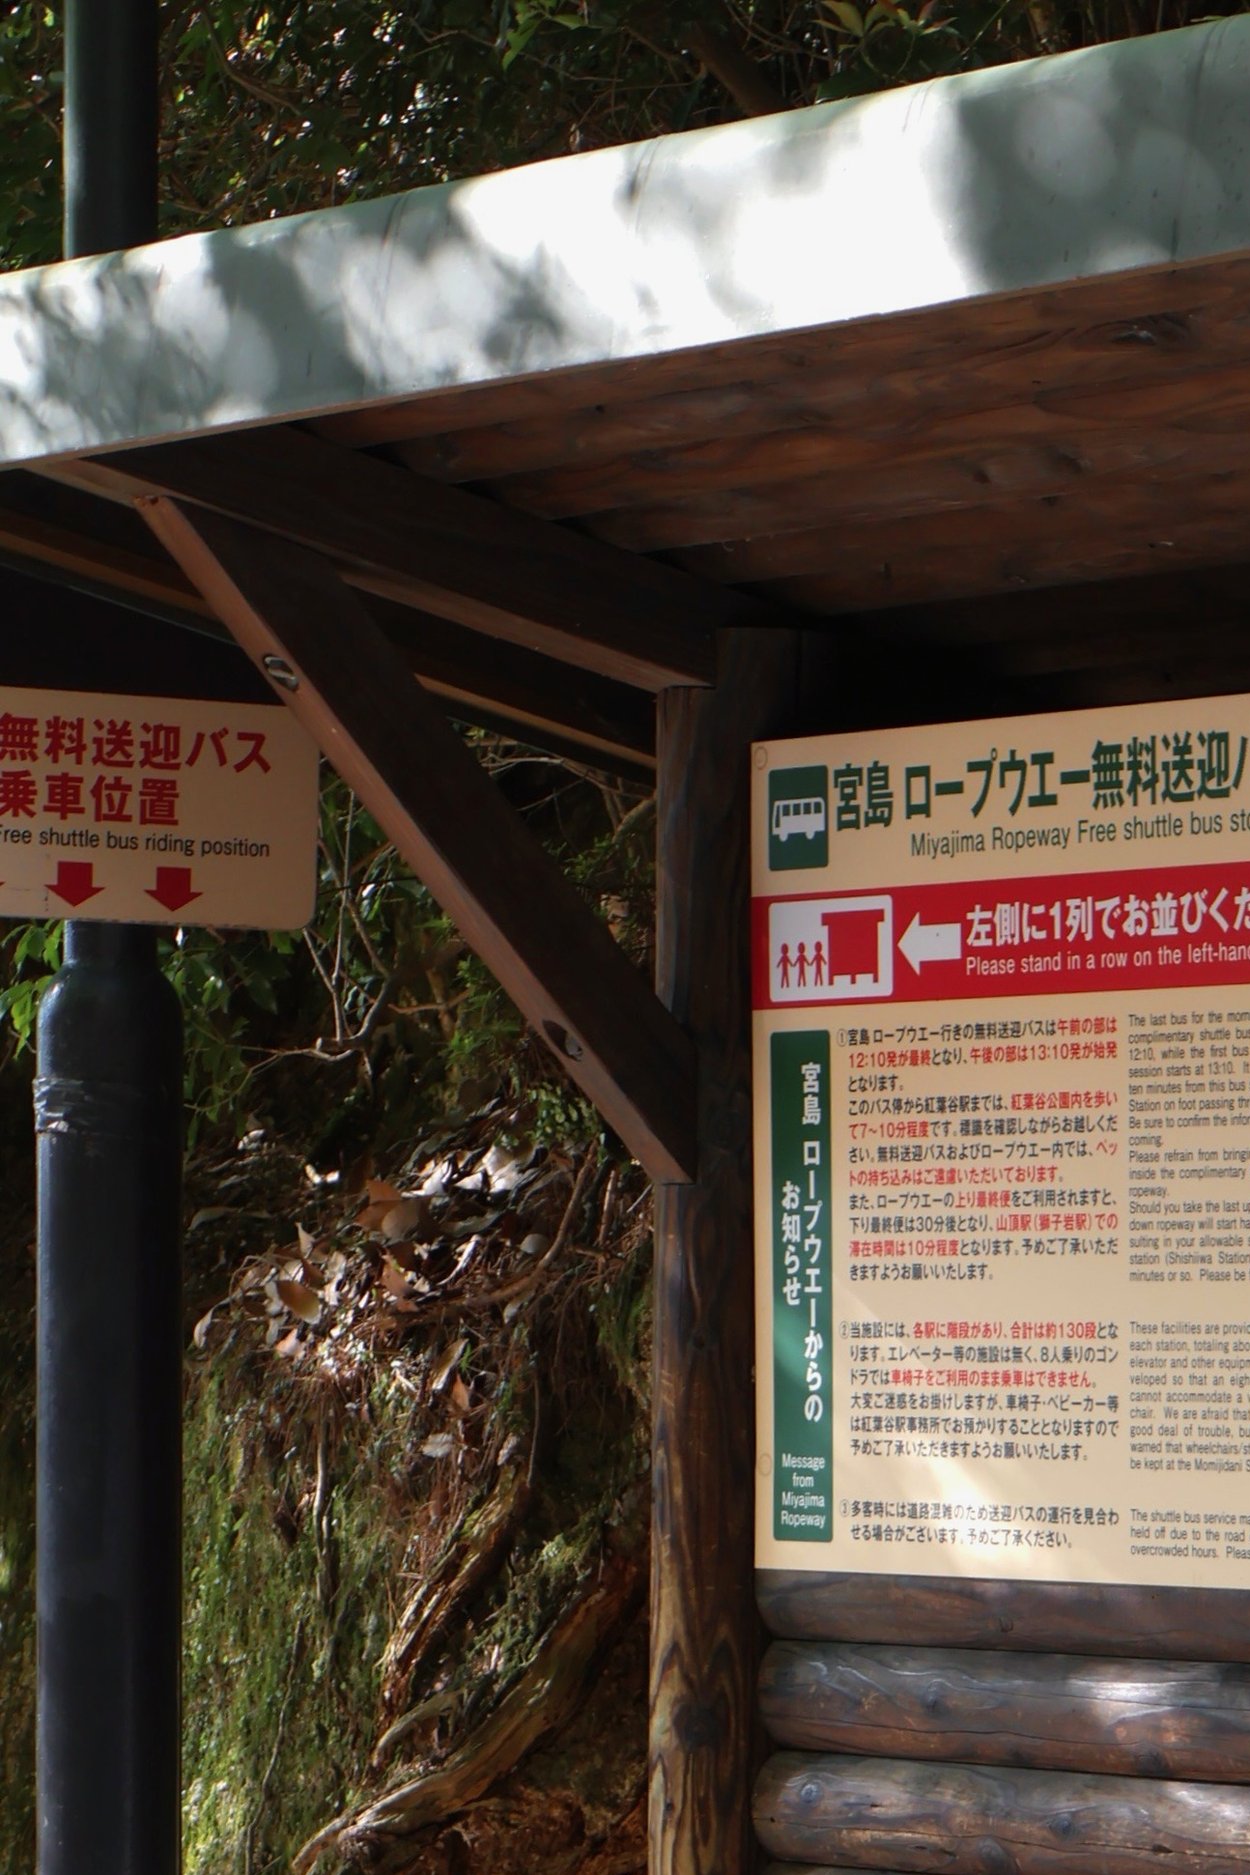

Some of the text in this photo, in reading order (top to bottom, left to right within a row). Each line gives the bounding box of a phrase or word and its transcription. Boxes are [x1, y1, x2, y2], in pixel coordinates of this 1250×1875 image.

[0, 712, 271, 774] 無料送迎バス
[0, 770, 180, 826] 乗車位置
[833, 760, 894, 832] 宮島
[0, 825, 270, 857] ree shuttle bus riding position
[911, 827, 986, 859] Miyajima
[992, 824, 1071, 853] Ropeway
[1078, 818, 1116, 843] Free
[1123, 813, 1183, 840] shuttle
[1191, 812, 1223, 837] bus
[966, 955, 1015, 976] Please
[1021, 952, 1063, 973] stand
[1068, 952, 1080, 970] in
[1085, 955, 1095, 970] a
[1101, 952, 1127, 968] row
[1134, 950, 1152, 966] on
[1157, 945, 1182, 965] the
[1129, 1014, 1146, 1027] The
[1150, 1013, 1166, 1026] last
[1171, 1013, 1187, 1025] bus
[1191, 1012, 1203, 1024] for
[1208, 1012, 1223, 1024] the
[802, 1062, 821, 1126] 宮島
[848, 1075, 904, 1092] となります。
[782, 1182, 800, 1305] お知らせ
[1130, 1321, 1158, 1334] These
[1161, 1322, 1201, 1334] facilities
[1204, 1324, 1220, 1334] are
[782, 1453, 825, 1470] Message
[793, 1472, 814, 1487] from
[782, 1491, 825, 1508] Miyajima
[781, 1511, 826, 1528] Ropeway
